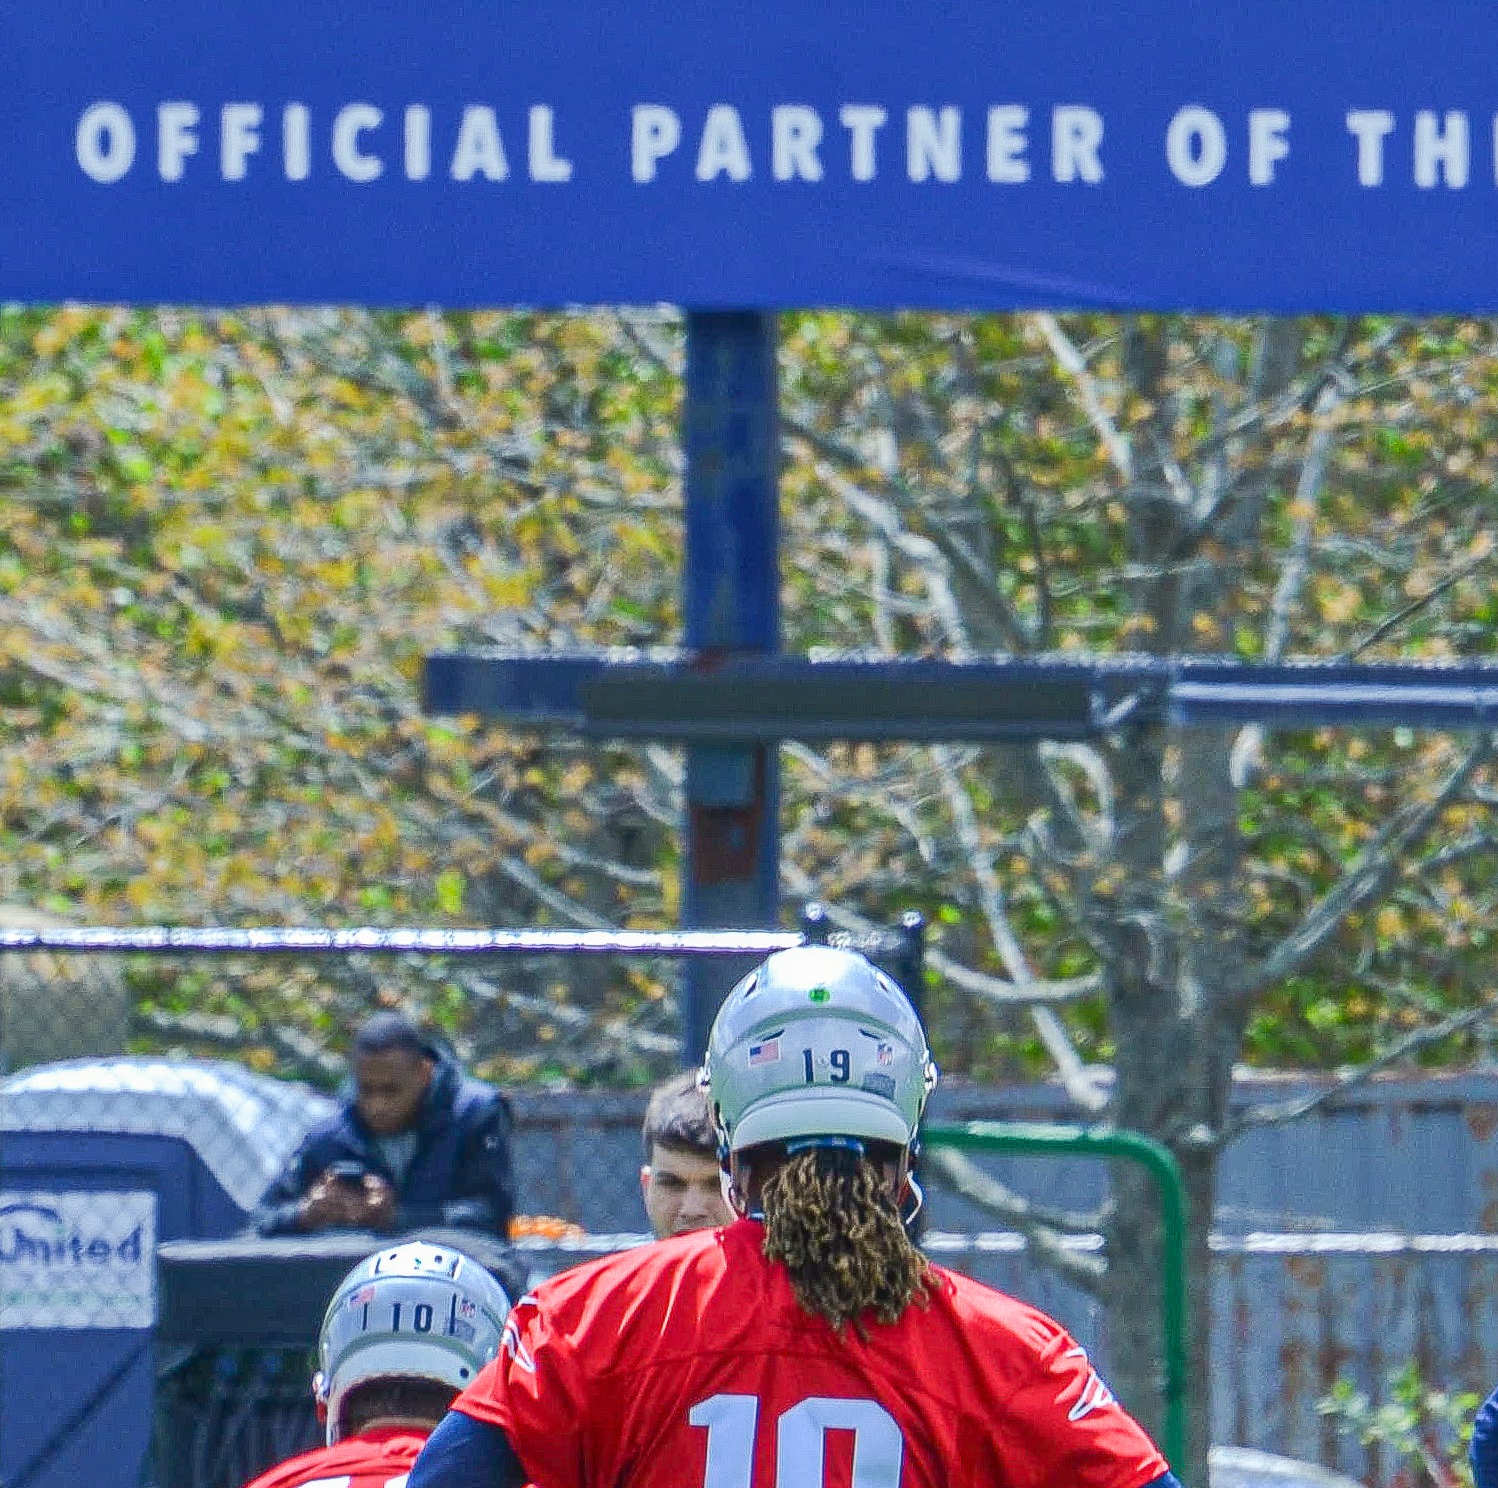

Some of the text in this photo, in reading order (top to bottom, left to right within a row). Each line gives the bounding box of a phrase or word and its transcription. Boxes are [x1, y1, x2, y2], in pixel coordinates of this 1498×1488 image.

[76, 103, 572, 182] OFFICIAL
[632, 105, 1103, 183] PARTNER
[1167, 106, 1290, 187] OF
[802, 1047, 851, 1083] 19
